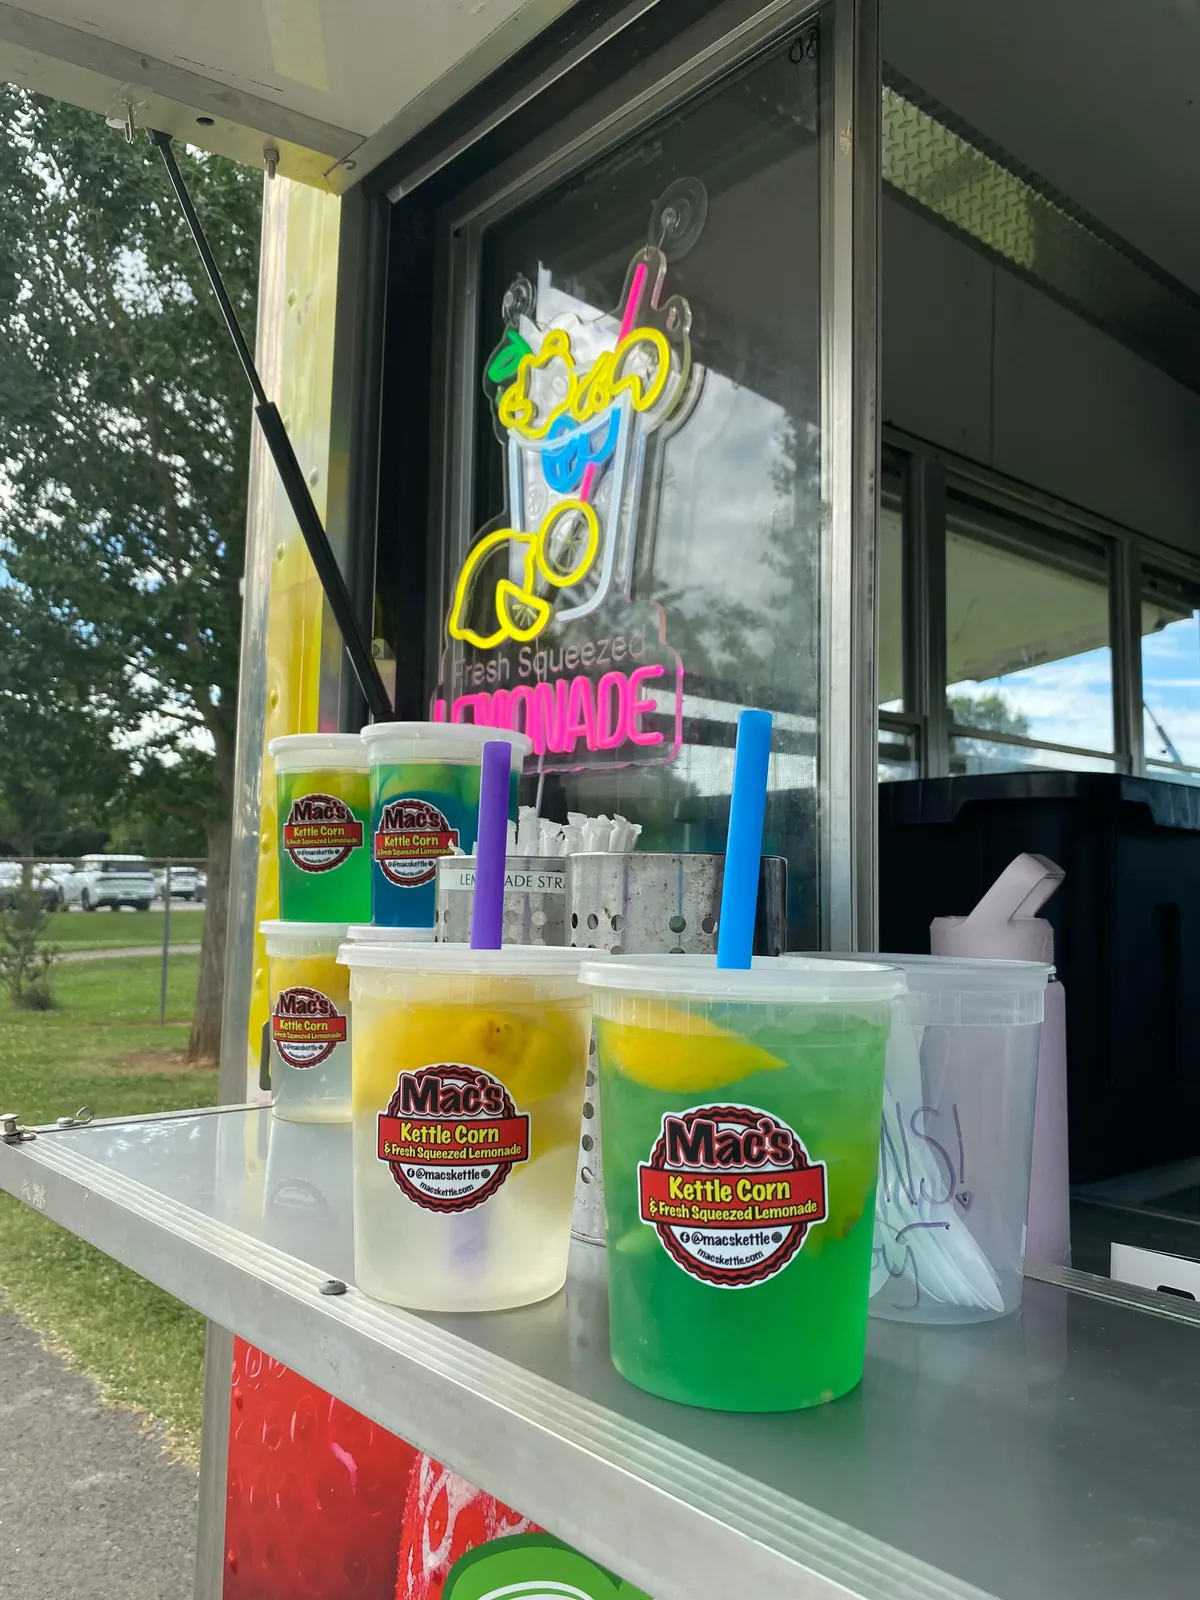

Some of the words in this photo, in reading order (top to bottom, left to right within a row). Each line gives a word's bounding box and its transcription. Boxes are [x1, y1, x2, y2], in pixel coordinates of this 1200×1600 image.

[453, 652, 510, 688] Fresh
[518, 624, 646, 681] Squeezed
[293, 800, 347, 822] Mac's
[383, 806, 441, 830] Mac's
[293, 826, 319, 837] Kettle
[320, 825, 345, 836] Corn
[384, 835, 411, 847] Kettle
[412, 834, 439, 846] Corn
[460, 873, 533, 888] LEADE
[279, 992, 330, 1016] Mac's
[279, 1019, 303, 1030] Kettle
[304, 1020, 328, 1031] Corn
[400, 1073, 505, 1117] Mac's
[400, 1122, 451, 1145] Kettle
[455, 1124, 499, 1144] Corn
[665, 1116, 794, 1168] Mac's
[384, 1140, 391, 1156] &
[392, 1144, 416, 1158] Fresh
[417, 1147, 467, 1161] Squeezed
[468, 1143, 522, 1159] Lemonade
[415, 1168, 480, 1180] @macskettle
[419, 1181, 474, 1196] macskettle.com
[669, 1175, 733, 1203] Kettle
[737, 1178, 791, 1202] Corn
[649, 1197, 658, 1217] &
[659, 1201, 690, 1219] Fresh
[691, 1205, 753, 1223] Squeezed
[754, 1200, 818, 1220] Lemonade
[691, 1231, 770, 1247] @macskettle
[697, 1248, 764, 1266] macskettle.com
